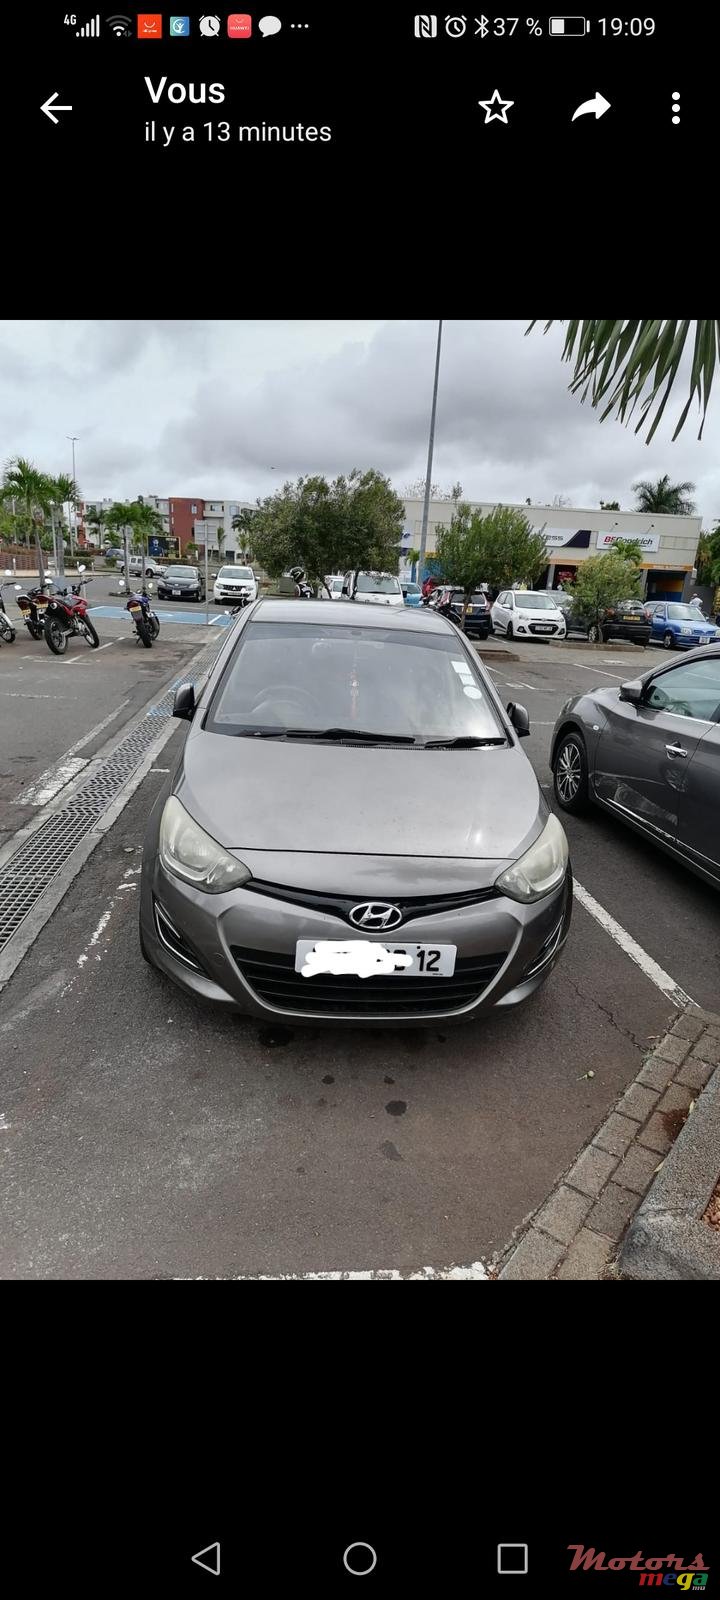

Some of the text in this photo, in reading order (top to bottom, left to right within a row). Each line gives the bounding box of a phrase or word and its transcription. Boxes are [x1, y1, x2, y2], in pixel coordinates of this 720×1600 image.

[63, 14, 77, 26] 4G
[493, 17, 543, 37] 37 %
[597, 17, 656, 37] 19:09
[143, 76, 226, 104] Vous
[144, 120, 332, 147] il y a 13 minutes
[416, 949, 441, 972] 12
